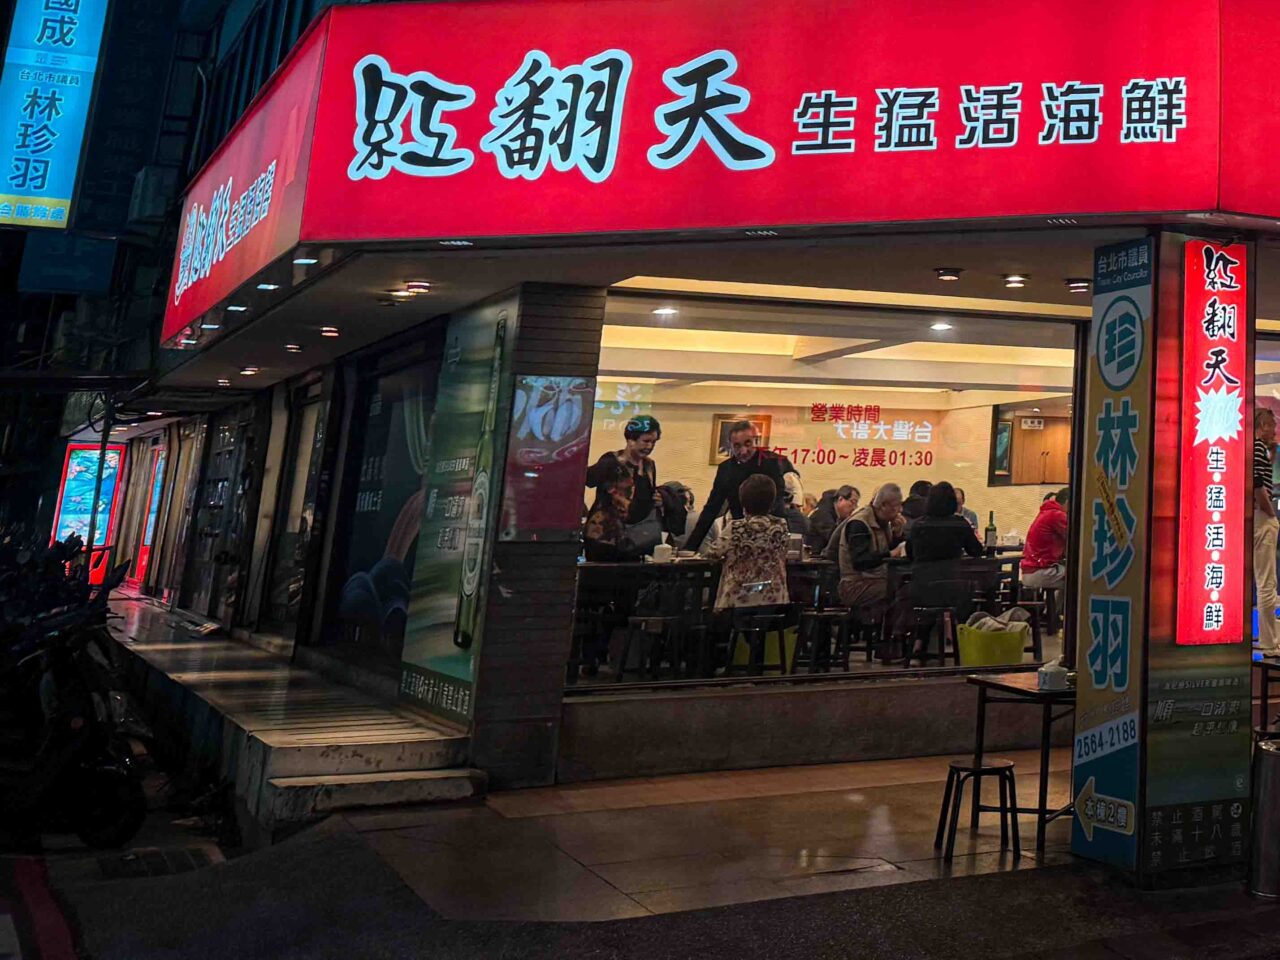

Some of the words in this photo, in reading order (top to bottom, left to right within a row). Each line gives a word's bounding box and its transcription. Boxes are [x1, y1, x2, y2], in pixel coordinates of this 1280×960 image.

[8, 87, 64, 191] 林珍羽
[347, 49, 776, 183] 紅翻天
[791, 76, 1189, 156] 生猛活海鮮
[1203, 245, 1241, 386] 紅翻天
[811, 402, 881, 424] 營業時間
[1076, 718, 1137, 759] 2564-2188
